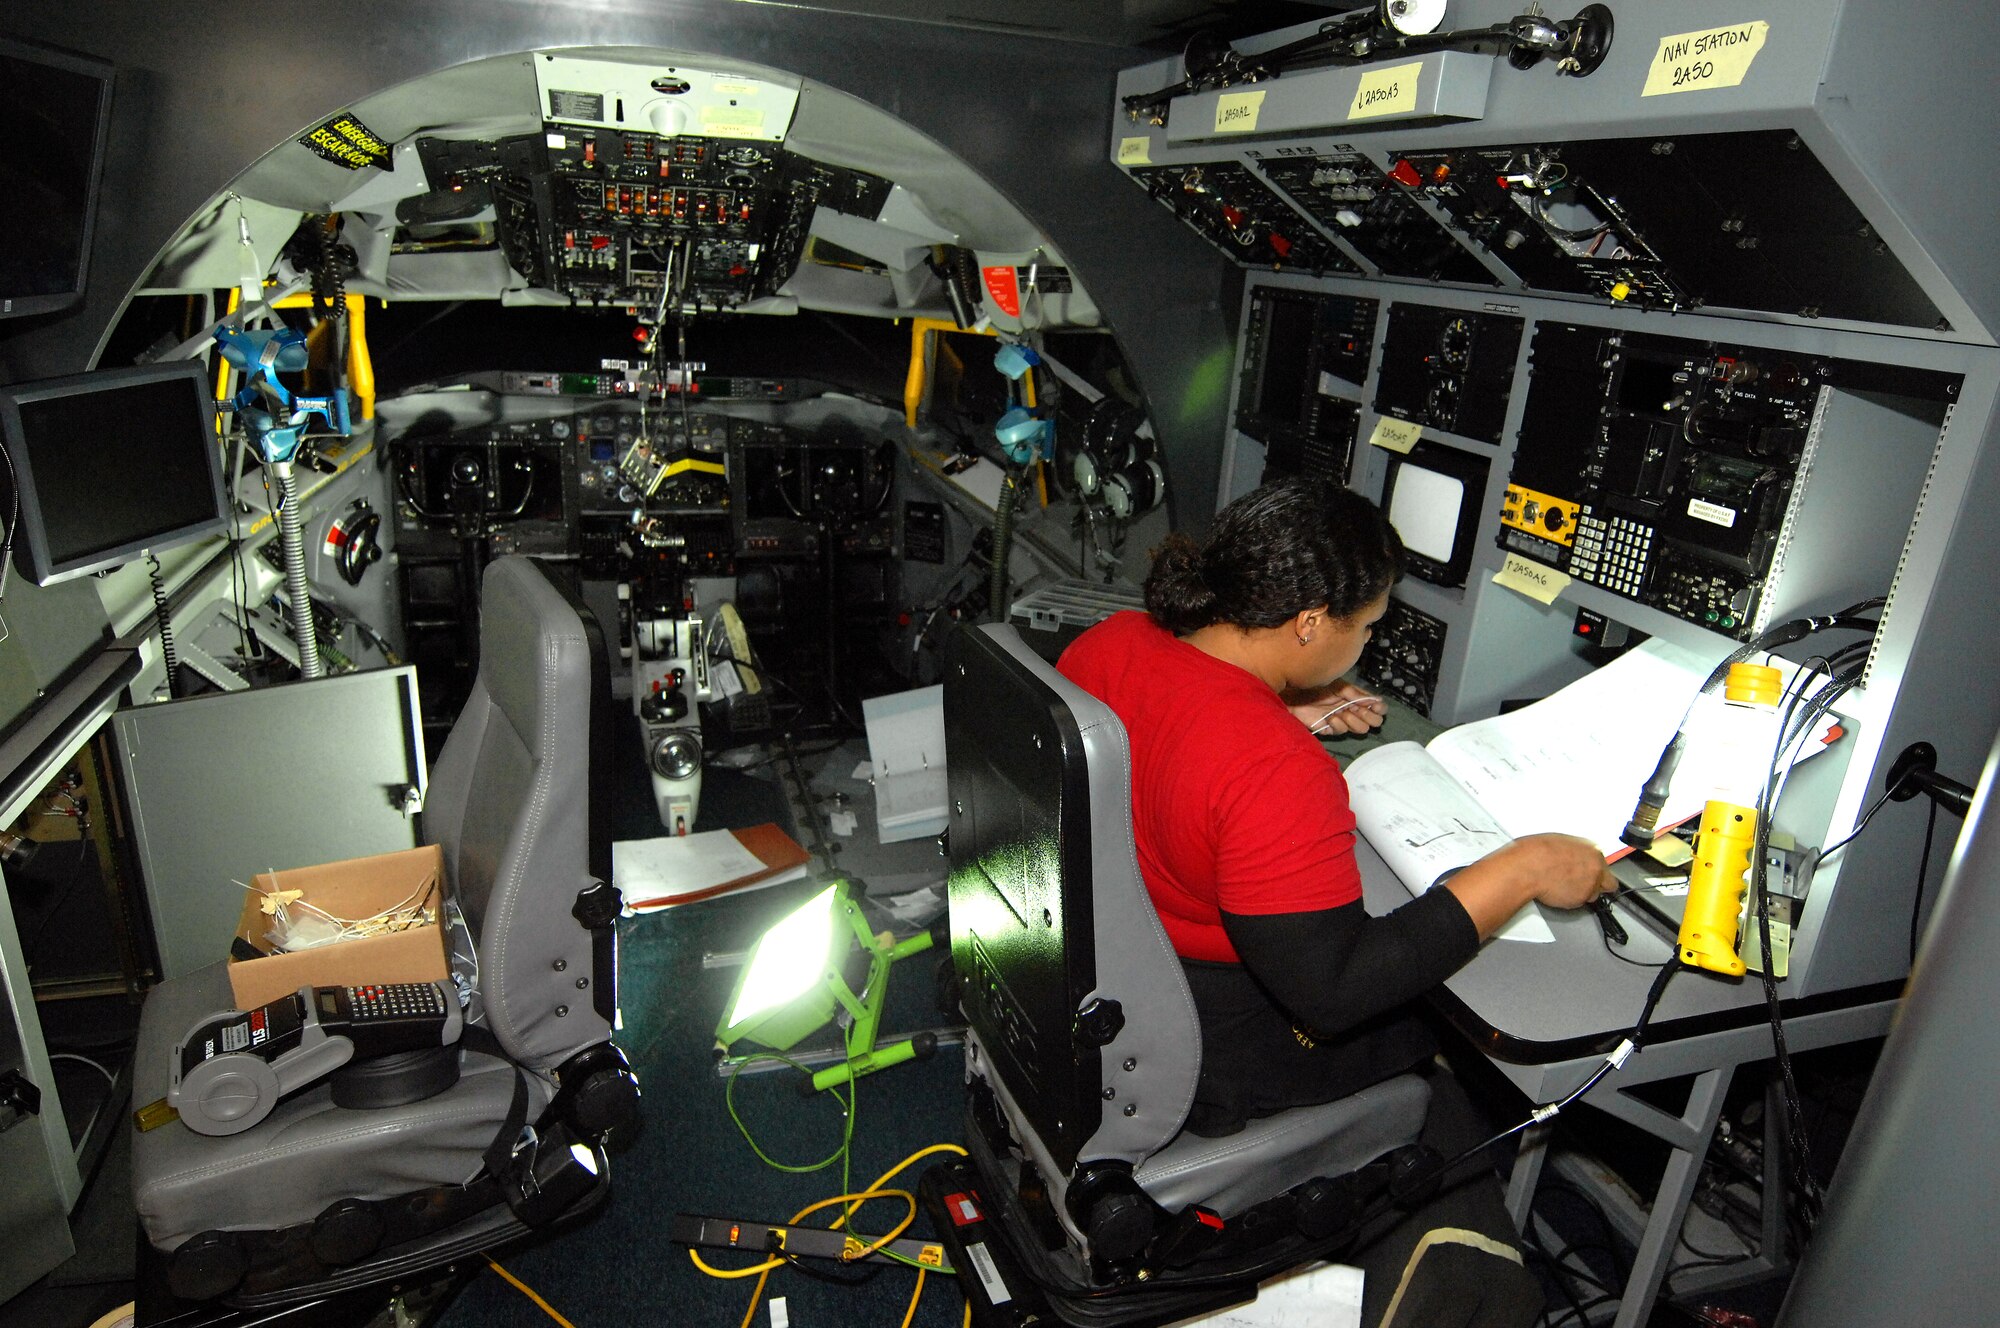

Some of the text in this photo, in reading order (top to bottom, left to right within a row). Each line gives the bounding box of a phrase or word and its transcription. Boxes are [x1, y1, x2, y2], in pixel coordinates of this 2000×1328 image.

[1663, 25, 1753, 63] NAV STATION
[1672, 61, 1714, 86] 2A50
[1512, 562, 1547, 586] 2A50A6
